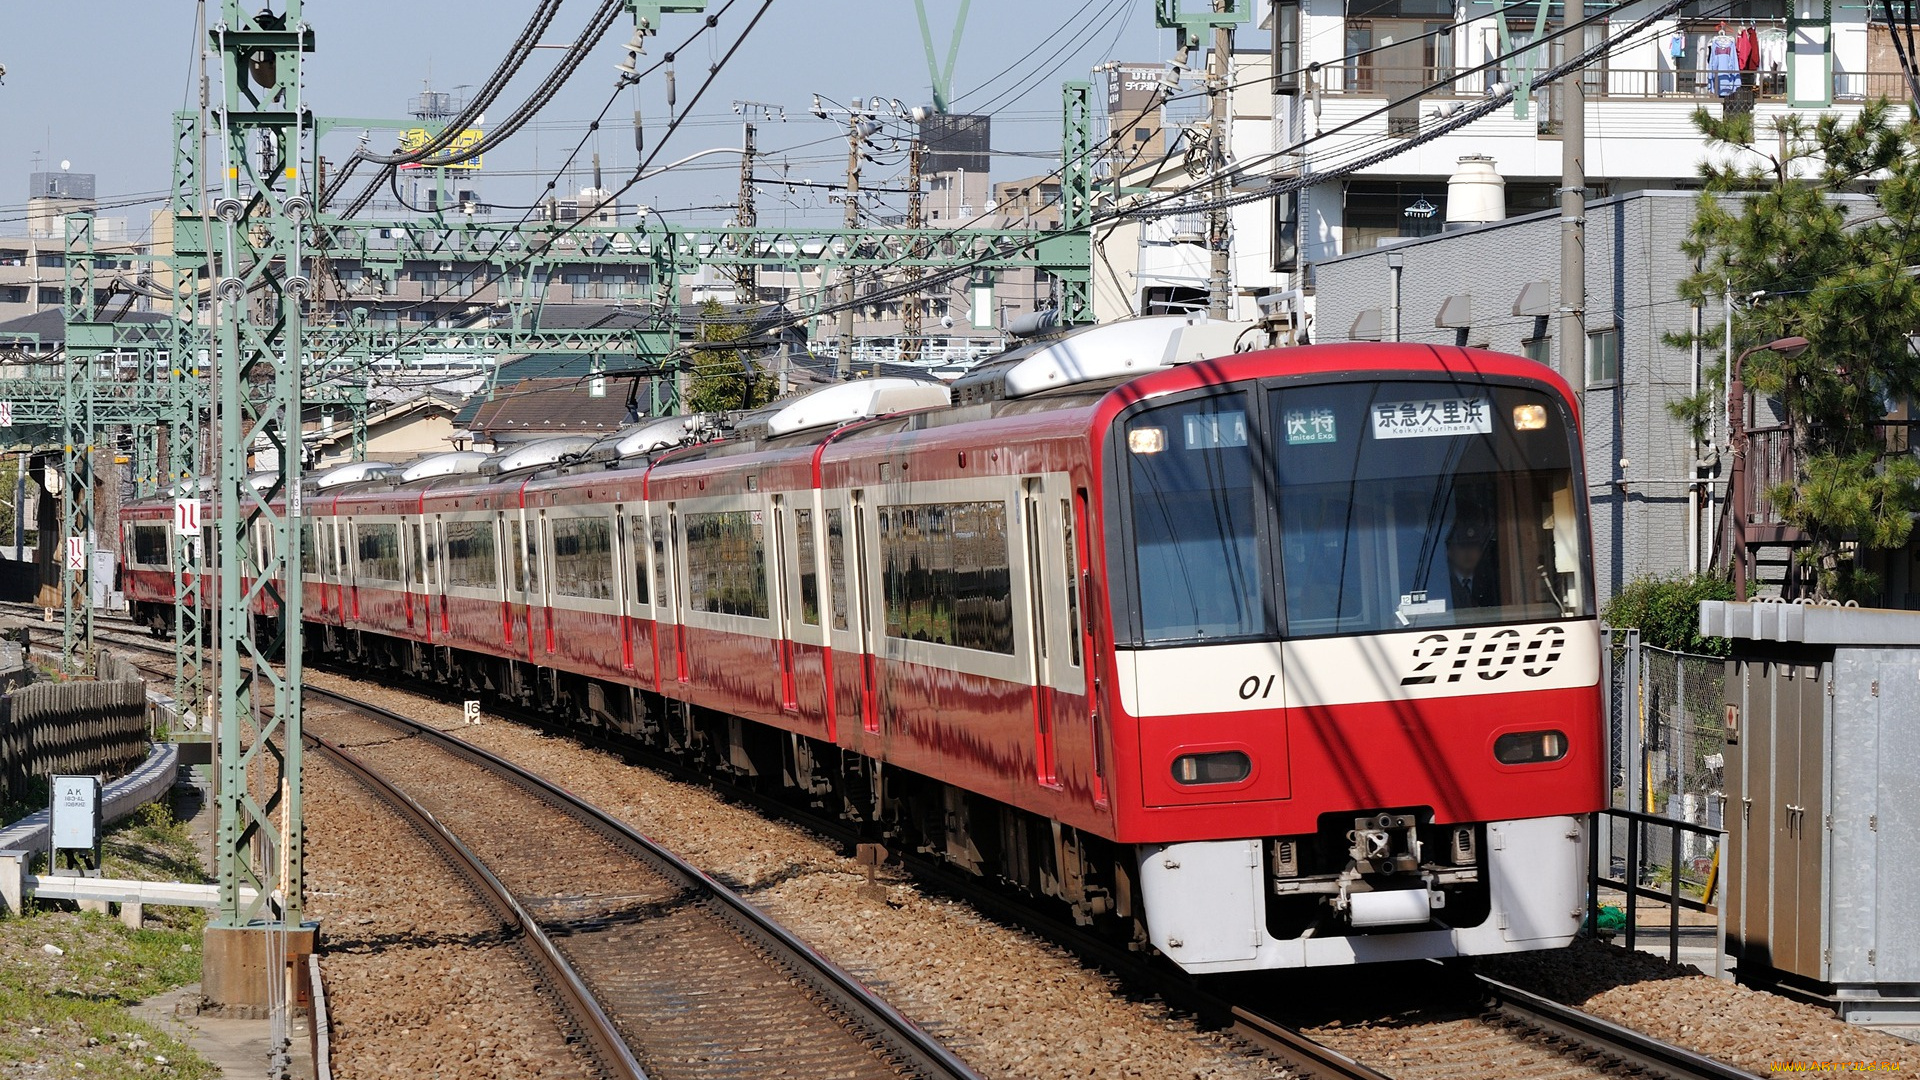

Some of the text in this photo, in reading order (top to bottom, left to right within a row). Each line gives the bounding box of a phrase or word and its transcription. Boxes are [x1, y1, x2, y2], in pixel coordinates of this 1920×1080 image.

[1284, 409, 1335, 435] 快特
[1377, 399, 1483, 428] 京急久里浜
[1428, 425, 1471, 433] Kurihama
[1400, 626, 1566, 686] 2100
[1238, 674, 1276, 700] 01
[467, 702, 481, 714] 16
